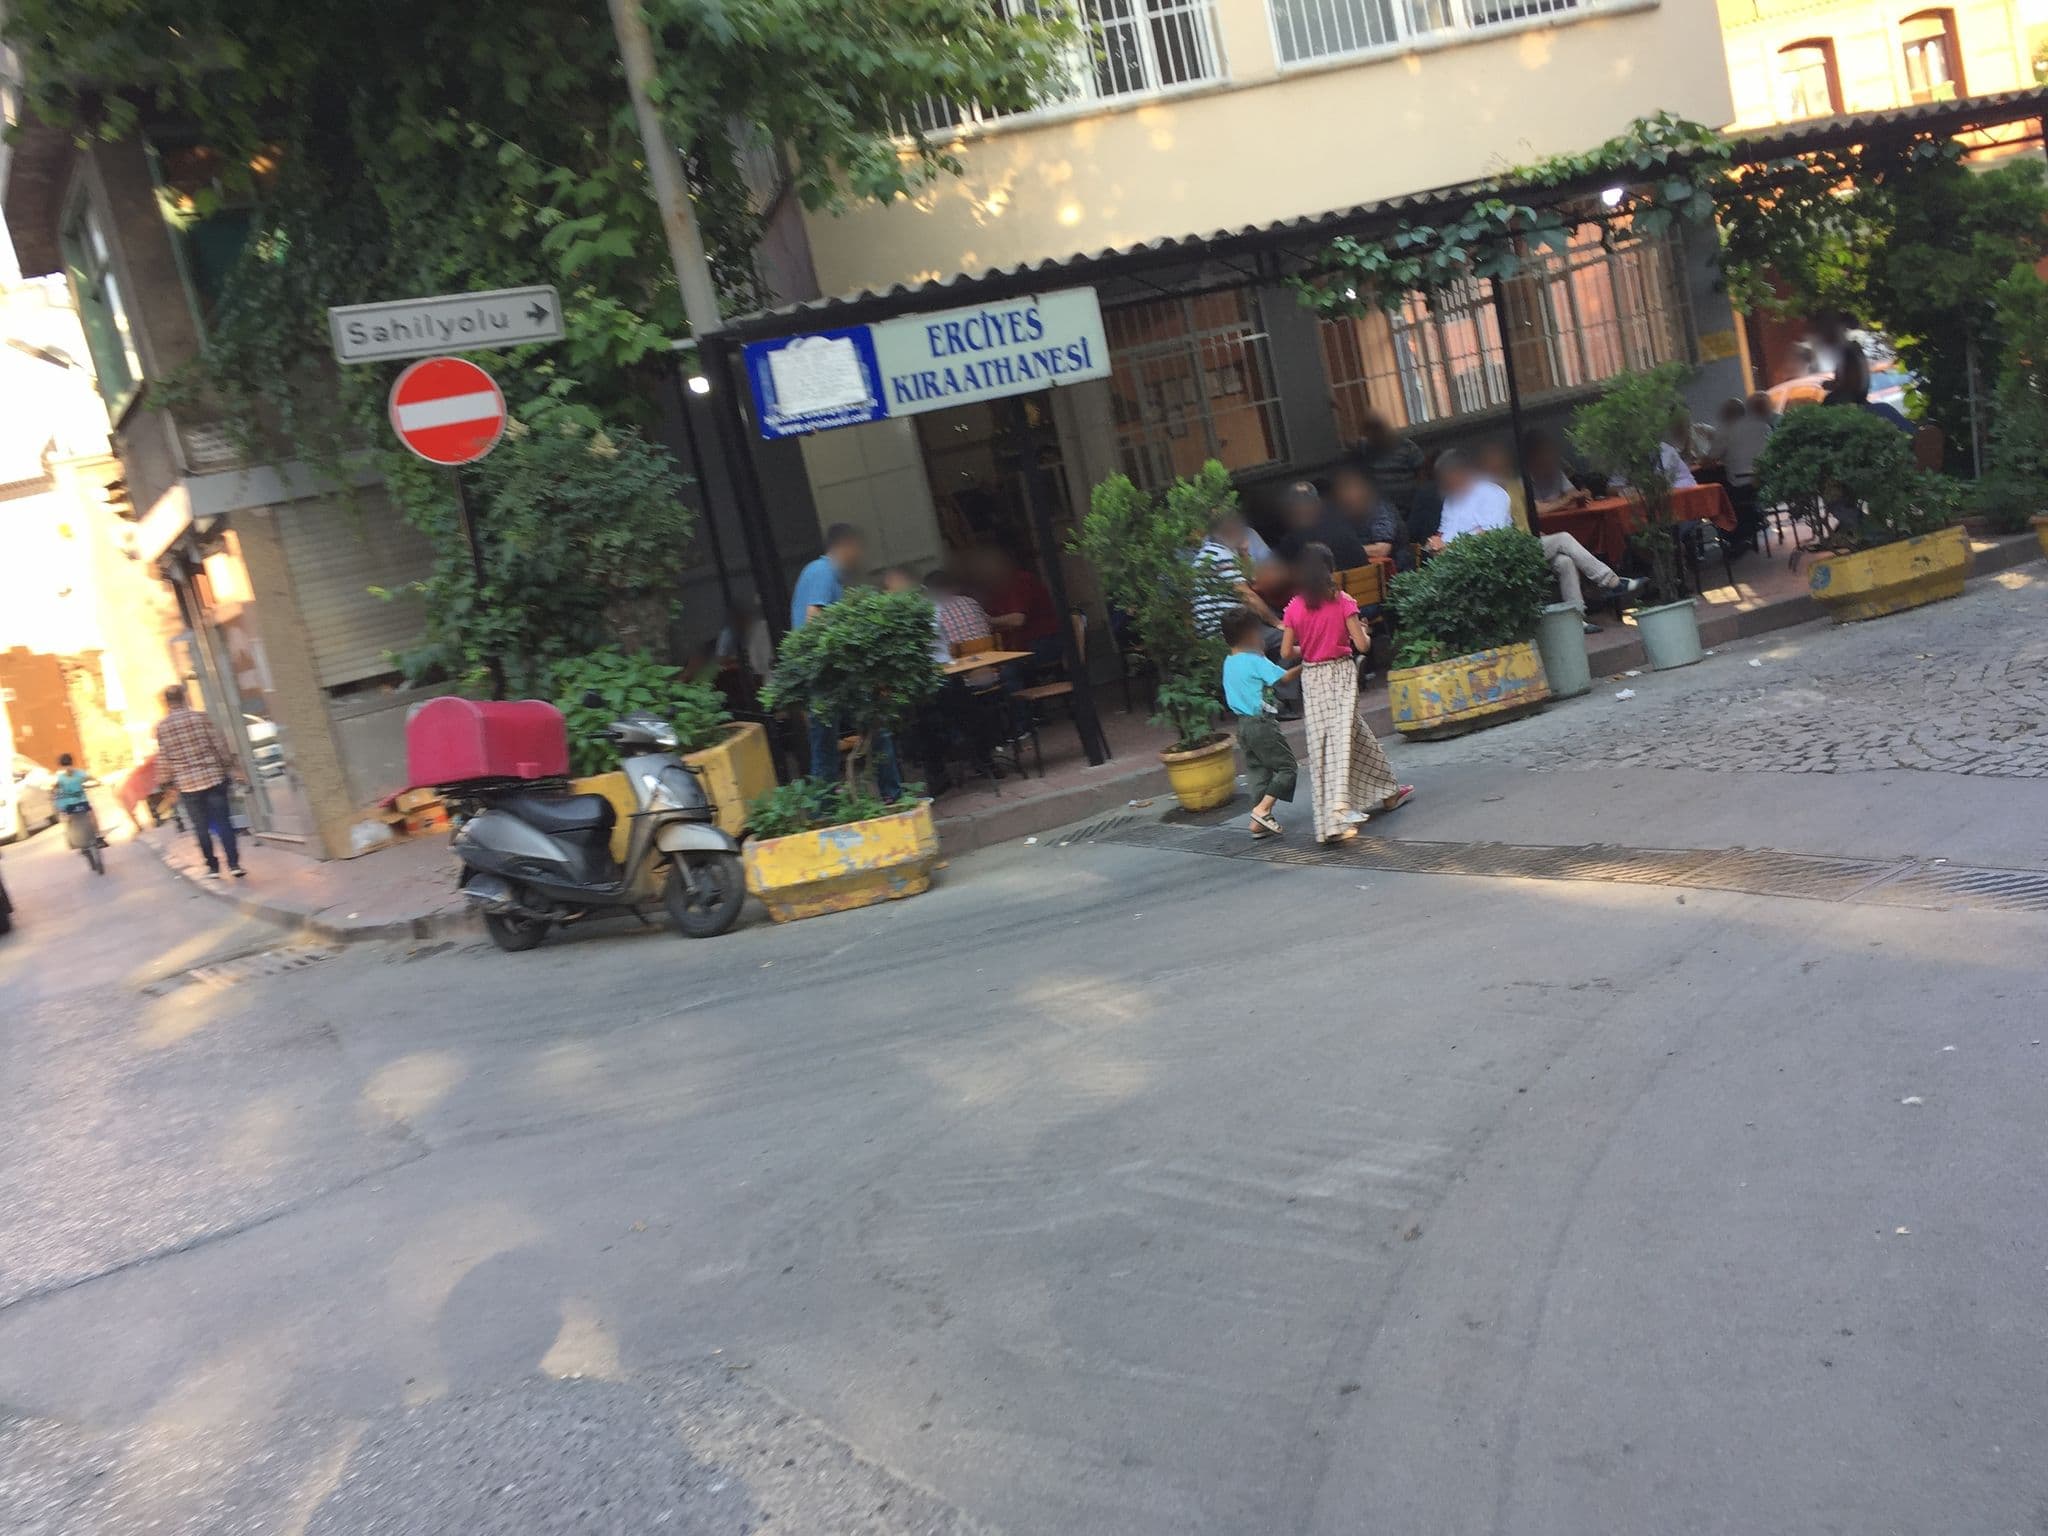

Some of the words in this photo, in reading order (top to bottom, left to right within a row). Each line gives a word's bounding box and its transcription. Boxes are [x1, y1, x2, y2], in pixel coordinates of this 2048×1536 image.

[348, 308, 510, 345] Sahilyolu
[926, 308, 1043, 357] ERCİYES
[891, 336, 1093, 404] KIRAATHANESİ
